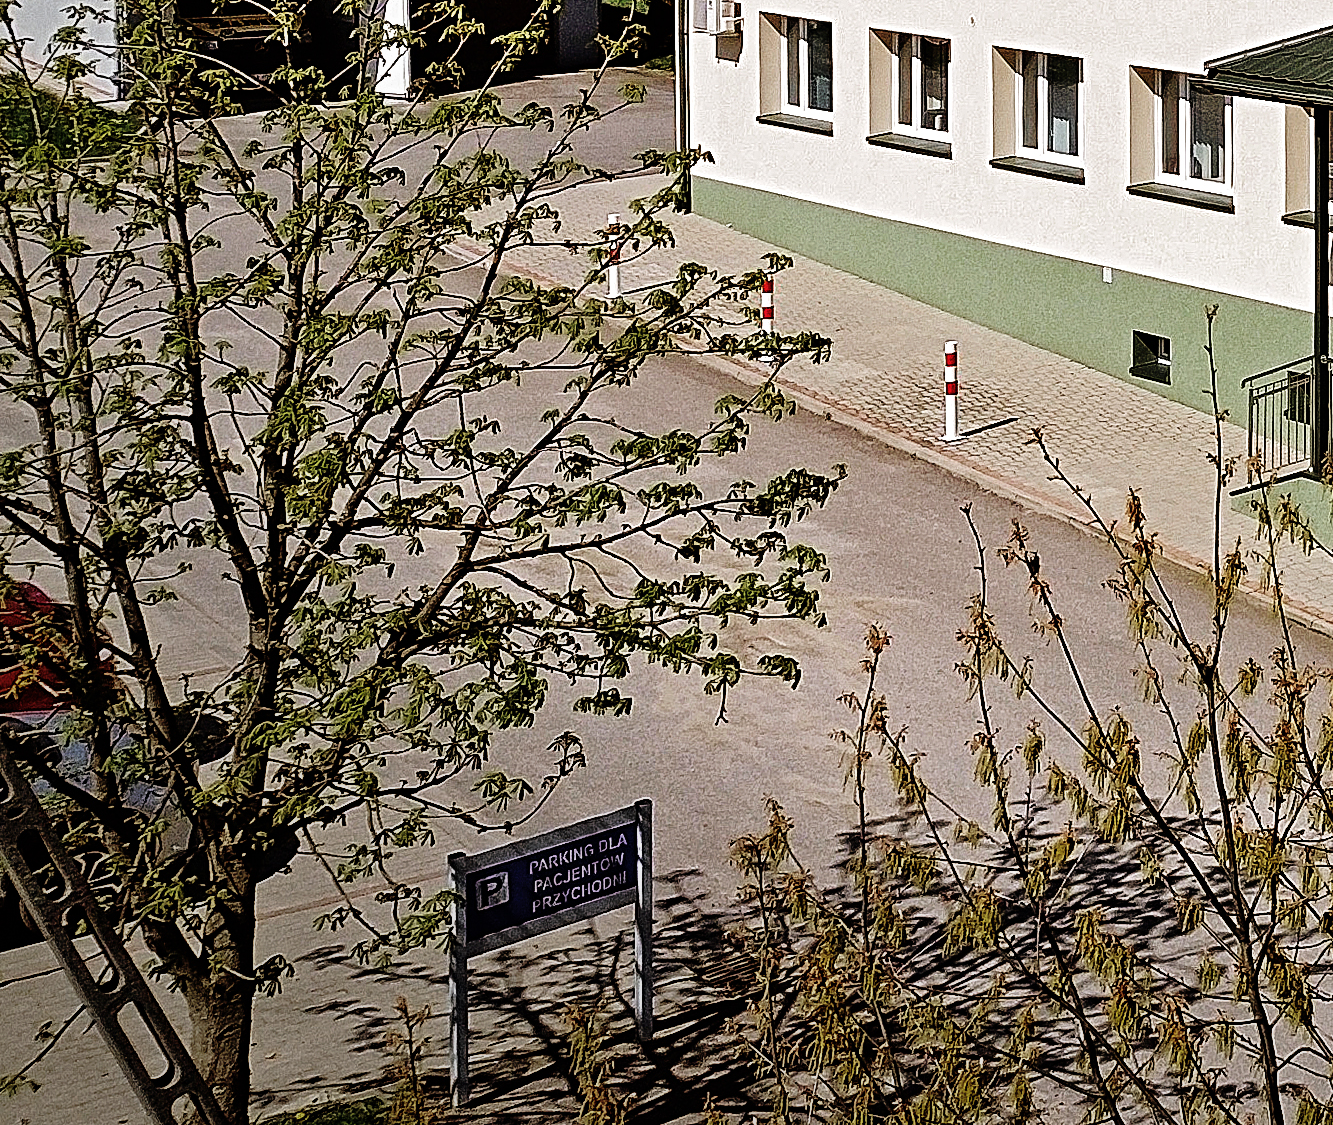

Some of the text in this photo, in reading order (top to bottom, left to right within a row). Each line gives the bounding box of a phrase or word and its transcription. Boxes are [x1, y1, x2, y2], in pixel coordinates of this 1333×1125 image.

[529, 833, 628, 875] PARKING DLA
[534, 852, 625, 893] PACJENTÓW
[532, 871, 627, 913] PRZYCHODNI
